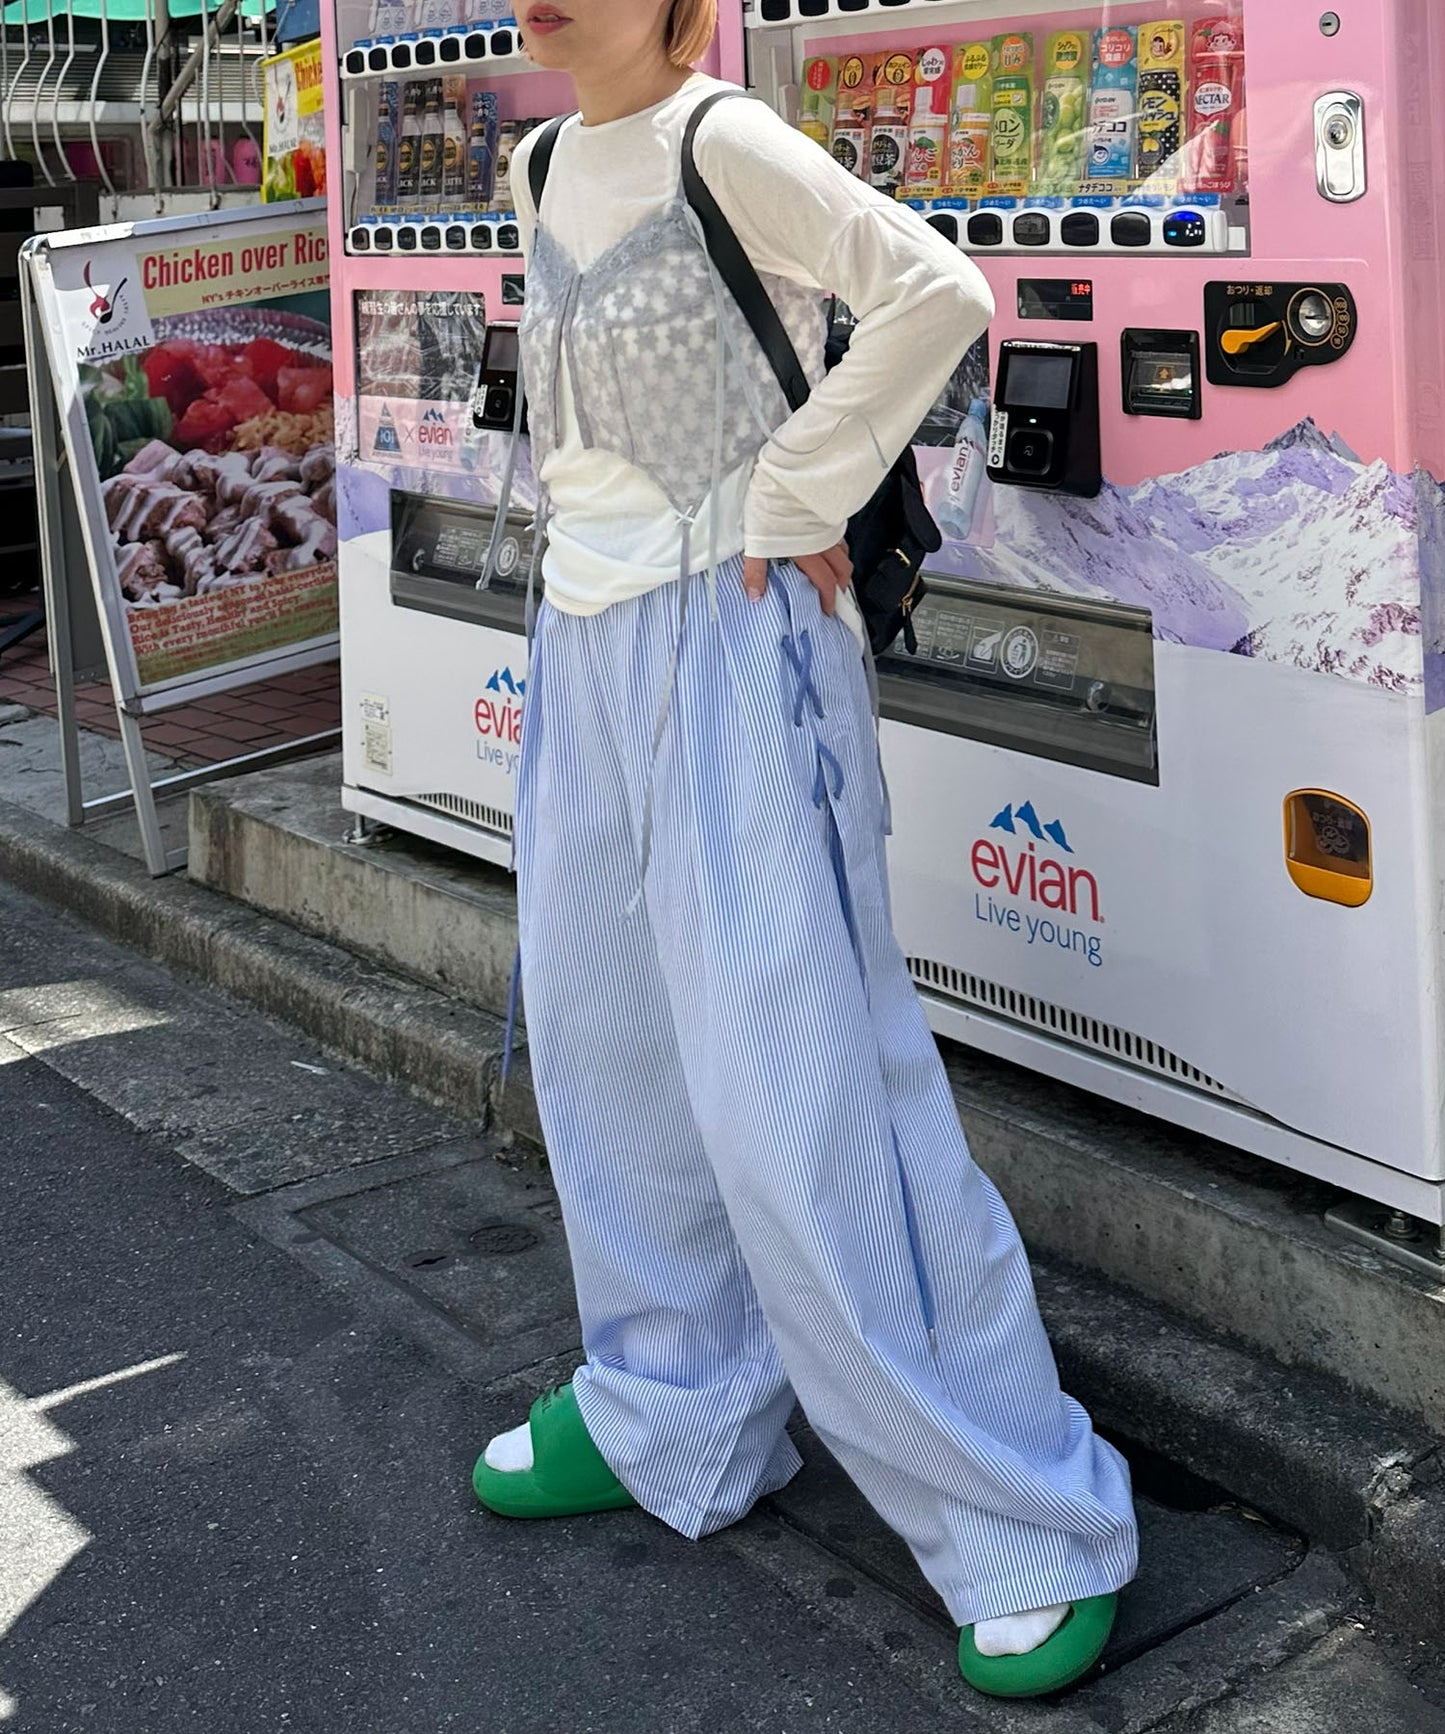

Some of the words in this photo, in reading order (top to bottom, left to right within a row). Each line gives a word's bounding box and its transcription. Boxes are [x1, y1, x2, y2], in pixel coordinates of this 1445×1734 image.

[1100, 43, 1130, 52] コリコリ
[1078, 183, 1114, 193] ナタデココ
[143, 249, 234, 290] Chicken
[242, 243, 288, 274] over
[294, 232, 329, 266] Ric
[1226, 285, 1273, 296] おつり・返却
[77, 336, 150, 358] Mr.HALAL
[418, 422, 454, 446] evian
[950, 444, 969, 492] evian
[126, 603, 177, 625] Bringing
[129, 620, 151, 633] Our
[154, 604, 214, 628] deliciously
[131, 630, 157, 644] Rice
[159, 627, 169, 637] is
[134, 640, 159, 655] With
[162, 634, 193, 650] every
[477, 740, 504, 766] Live
[971, 839, 1099, 922] evian
[974, 892, 1020, 932] Live
[1026, 912, 1103, 968] young
